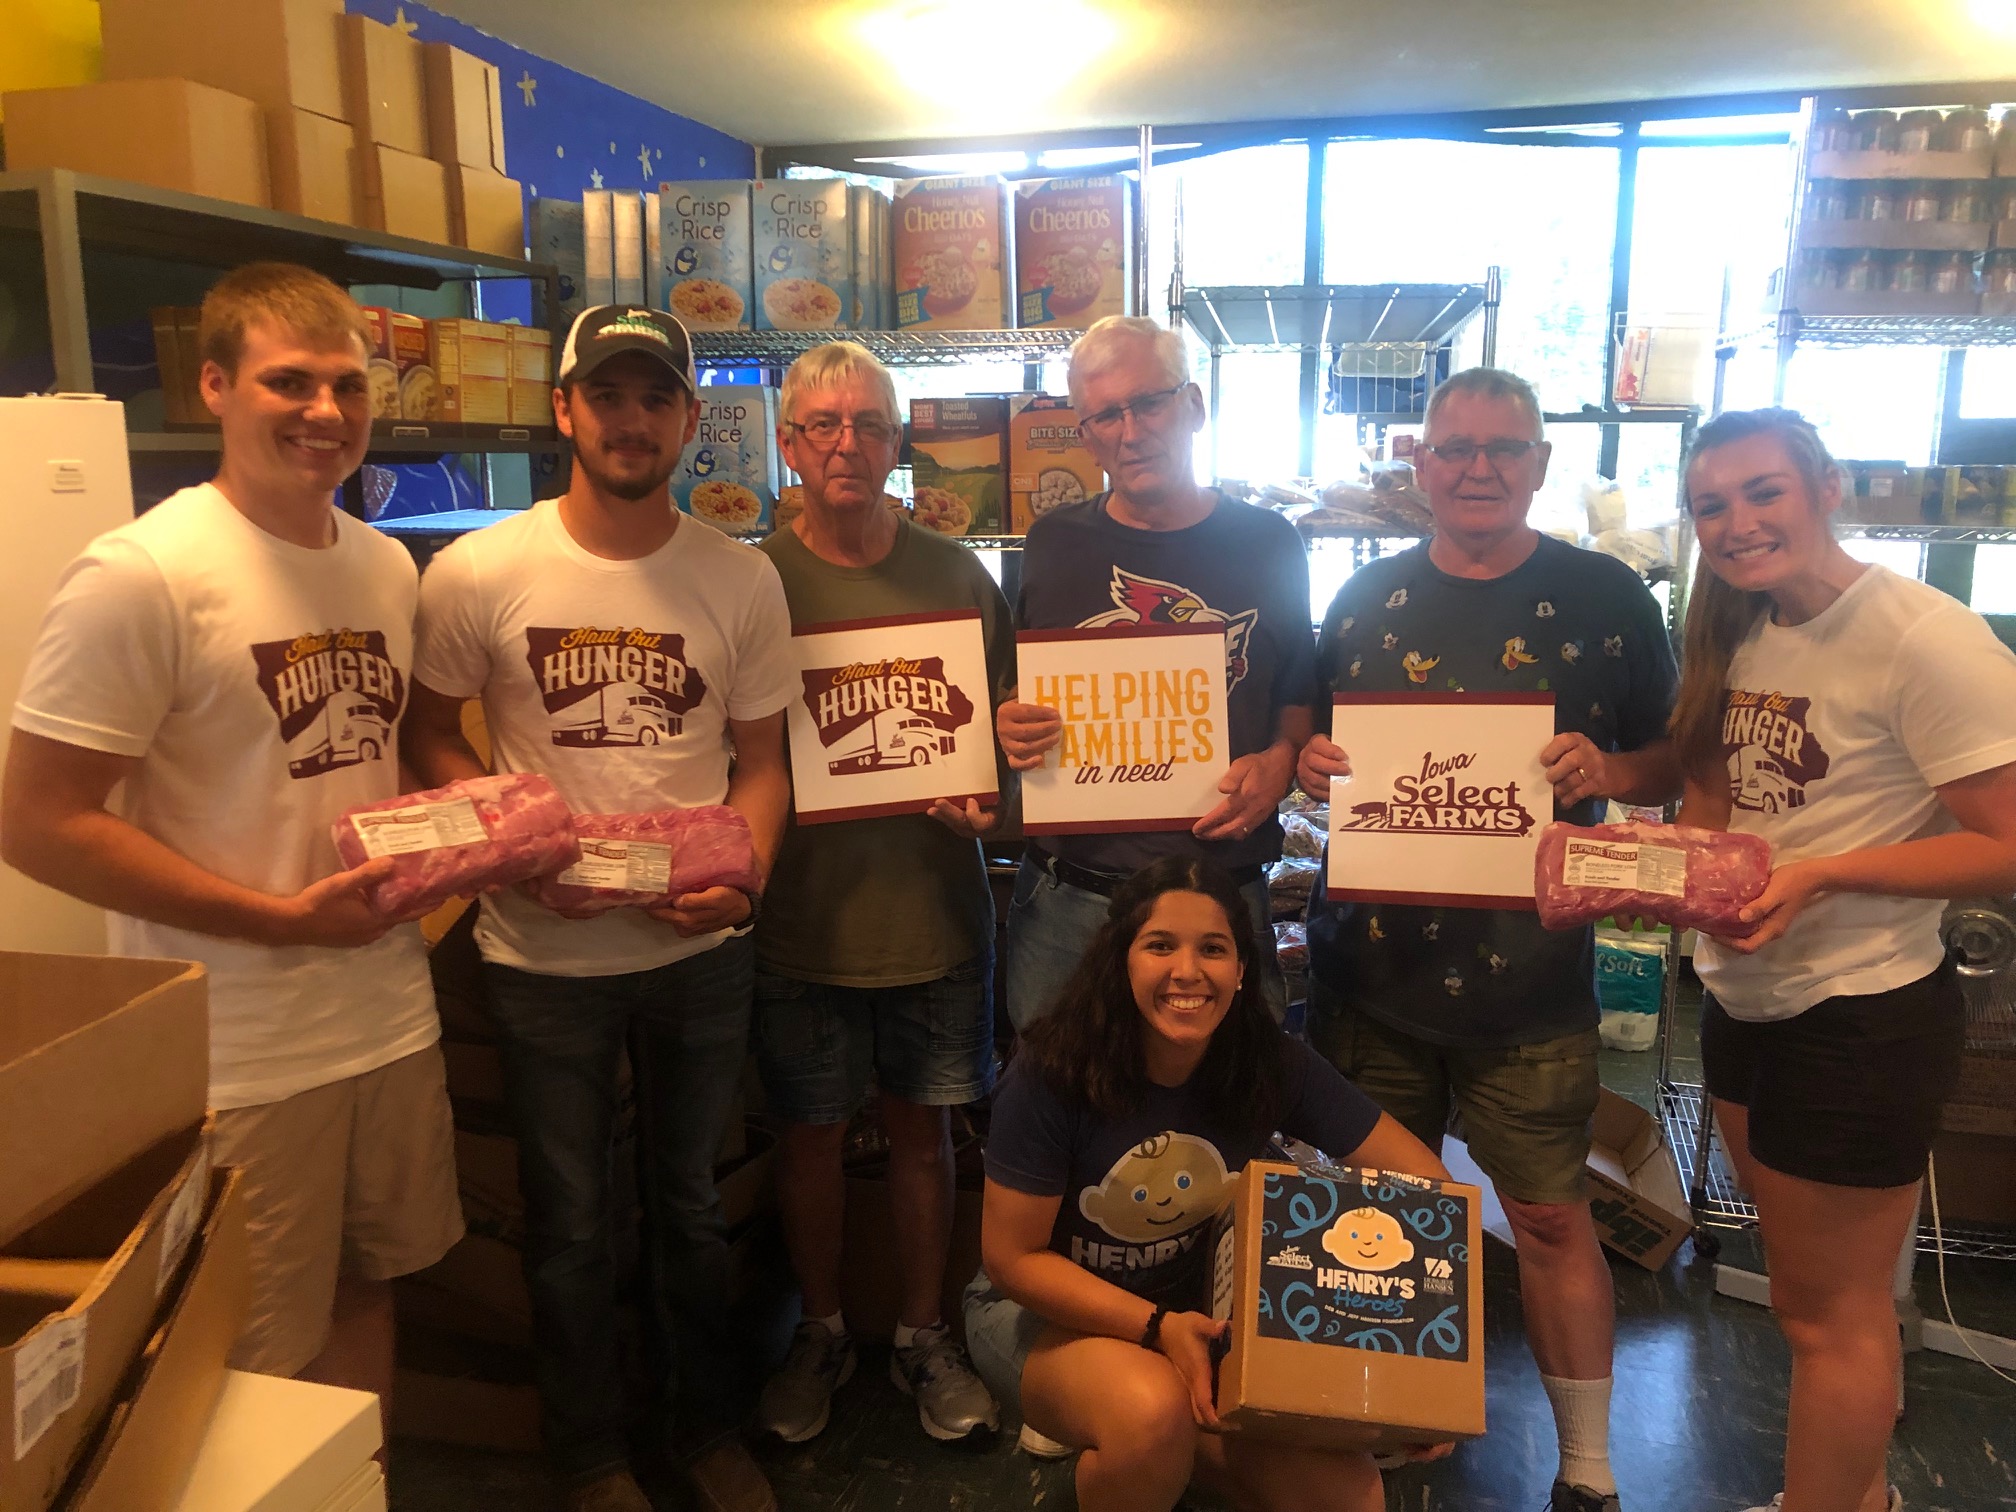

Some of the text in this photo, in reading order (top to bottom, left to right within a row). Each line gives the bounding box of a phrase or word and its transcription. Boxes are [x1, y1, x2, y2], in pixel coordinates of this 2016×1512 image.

[675, 195, 731, 220] Crisp
[771, 193, 828, 220] Crisp
[904, 206, 986, 233] Cheerios
[1029, 207, 1111, 233] Cheerios
[681, 219, 726, 240] Rice
[776, 218, 823, 239] Rice
[699, 400, 747, 427] Crisp
[914, 410, 934, 418] BEST
[700, 423, 743, 443] Rice
[1030, 427, 1079, 439] BITE SIZ
[560, 626, 662, 649] Haul Out
[543, 645, 688, 695] HUNGER
[832, 657, 922, 685] Haul Out
[273, 650, 396, 721] HUNGER
[1034, 668, 1210, 722] HELPING
[818, 675, 954, 730] HUNGER
[1038, 718, 1214, 769] AMILIES
[1722, 707, 1804, 767] UNGER
[1074, 755, 1176, 785] in need
[1419, 751, 1477, 785] Iowa
[1392, 775, 1521, 806] Select
[1391, 806, 1522, 830] FARMS
[1570, 844, 1637, 860] SUPREME TENDER
[1604, 956, 1646, 977] Soft
[1279, 1250, 1310, 1261] Select
[1316, 1267, 1416, 1300] HENRY'S
[1333, 1286, 1407, 1317] Heroes
